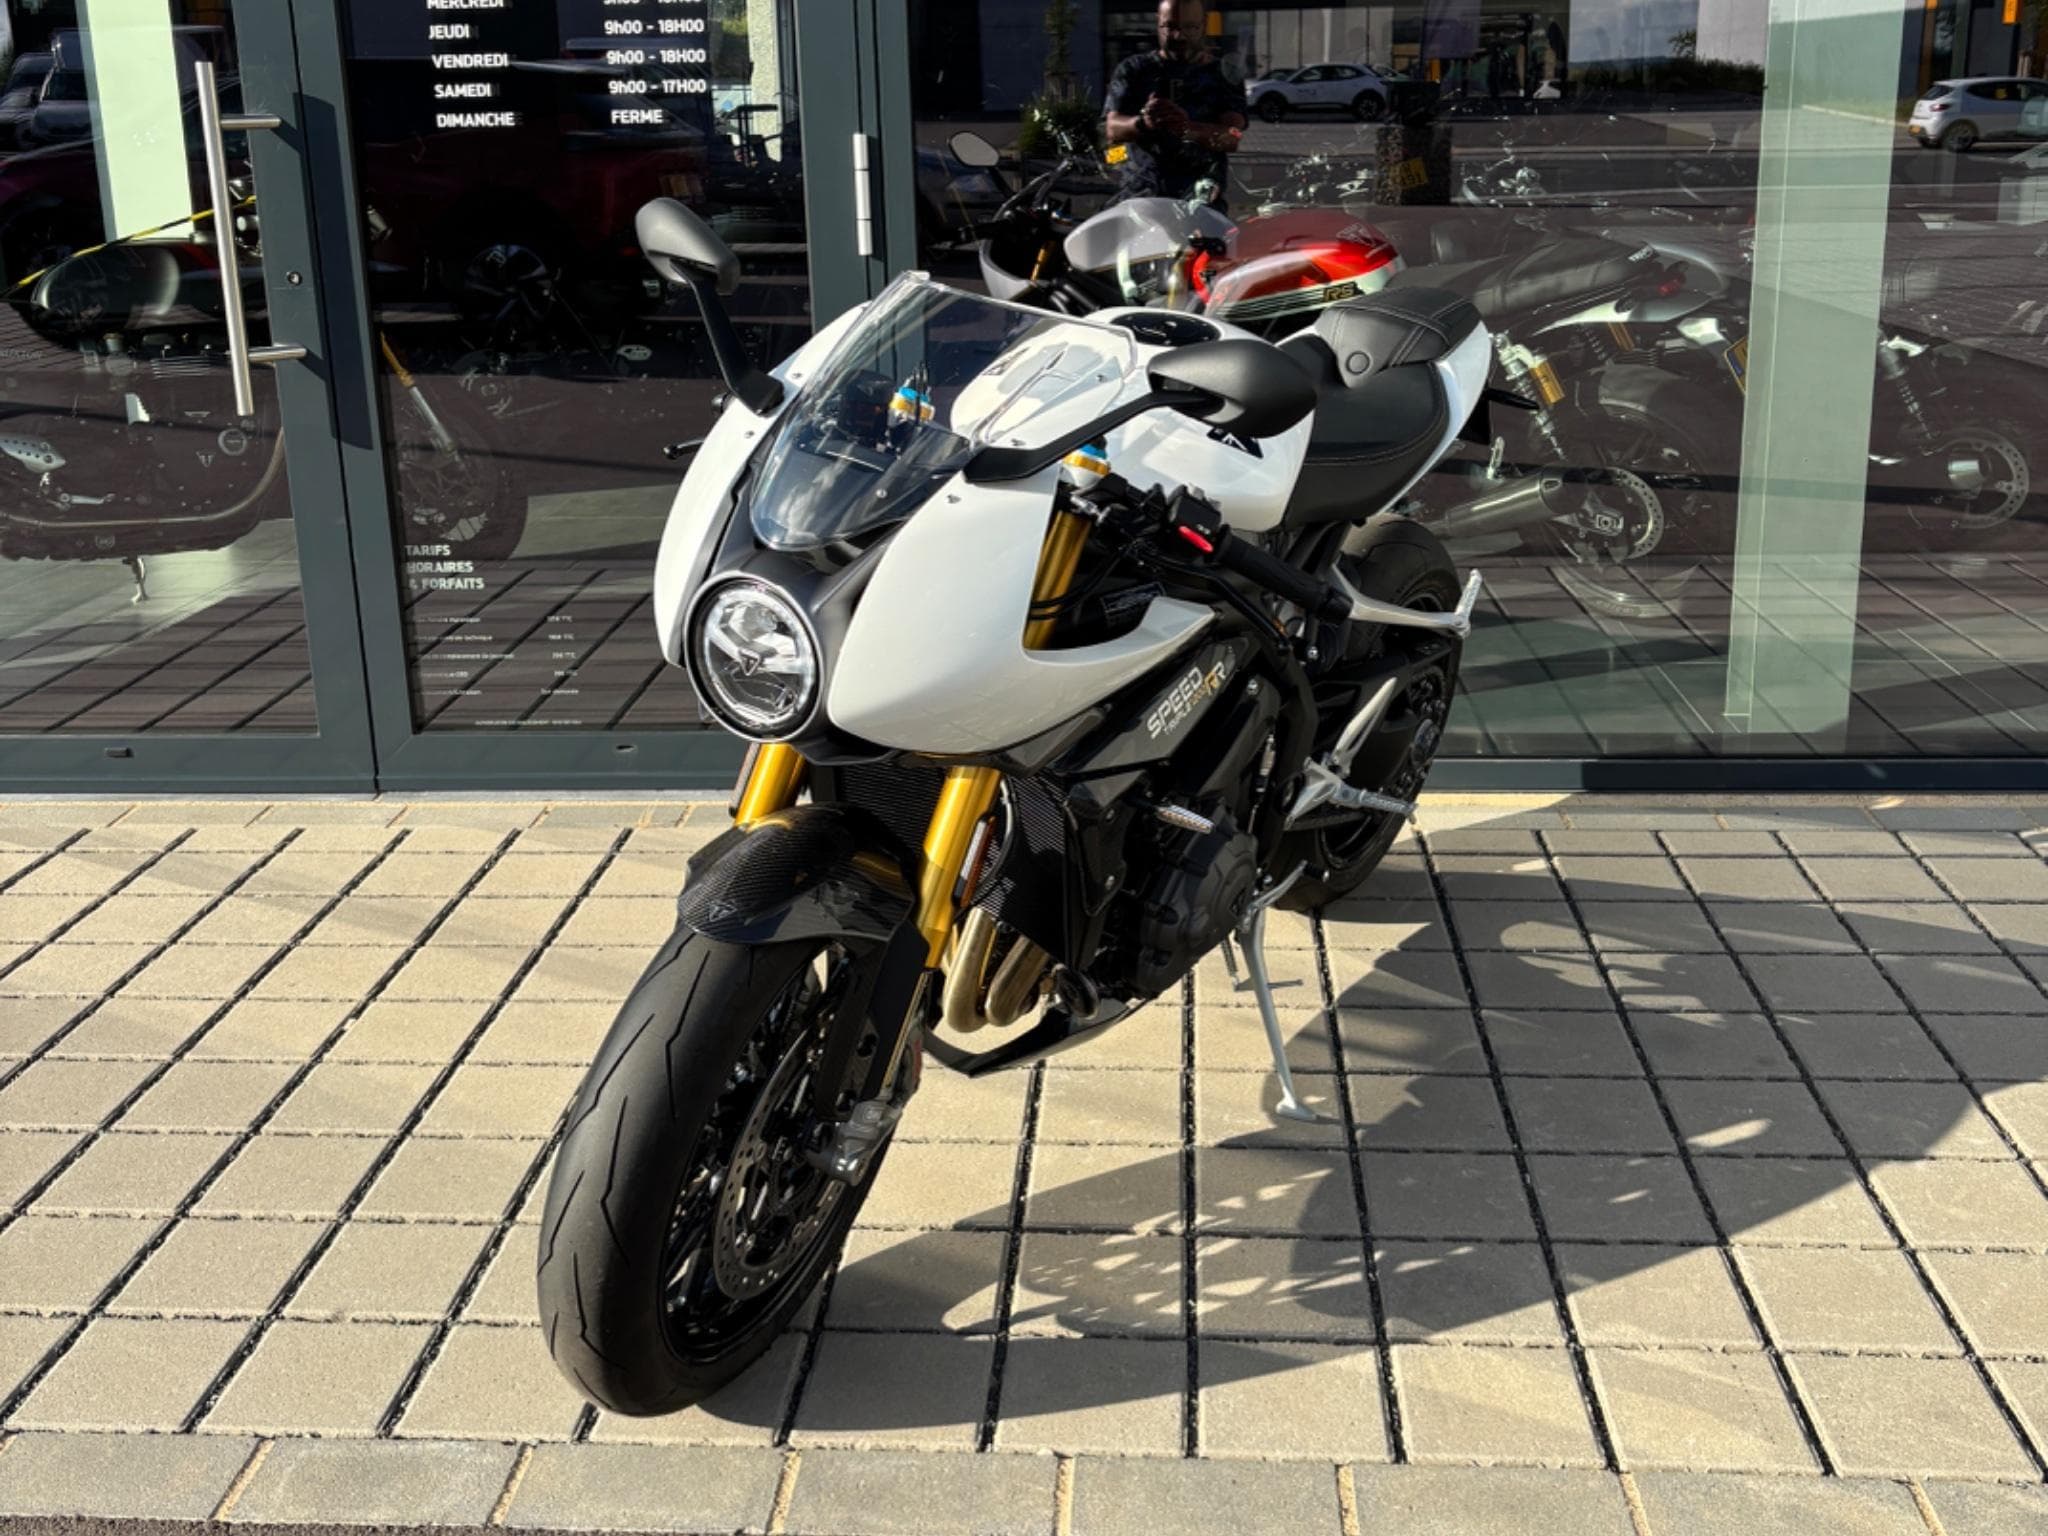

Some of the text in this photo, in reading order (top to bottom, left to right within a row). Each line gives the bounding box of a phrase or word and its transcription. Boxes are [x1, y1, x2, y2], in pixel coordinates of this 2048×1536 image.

[428, 23, 470, 40] JEUDI
[604, 19, 643, 34] 9h00
[658, 18, 704, 34] 18H00
[431, 53, 508, 69] VENDREDI
[606, 49, 645, 65] 9h00
[660, 48, 706, 63] 18H00
[434, 83, 492, 99] SAMEDI
[608, 79, 647, 95] 9h00
[662, 78, 706, 94] 17H00
[436, 109, 663, 128] DIMANCHE FERME
[404, 544, 451, 556] TARIFS
[406, 560, 474, 574] HORAIRES
[422, 577, 485, 590] FORFAITS
[1147, 667, 1203, 739] SPEED
